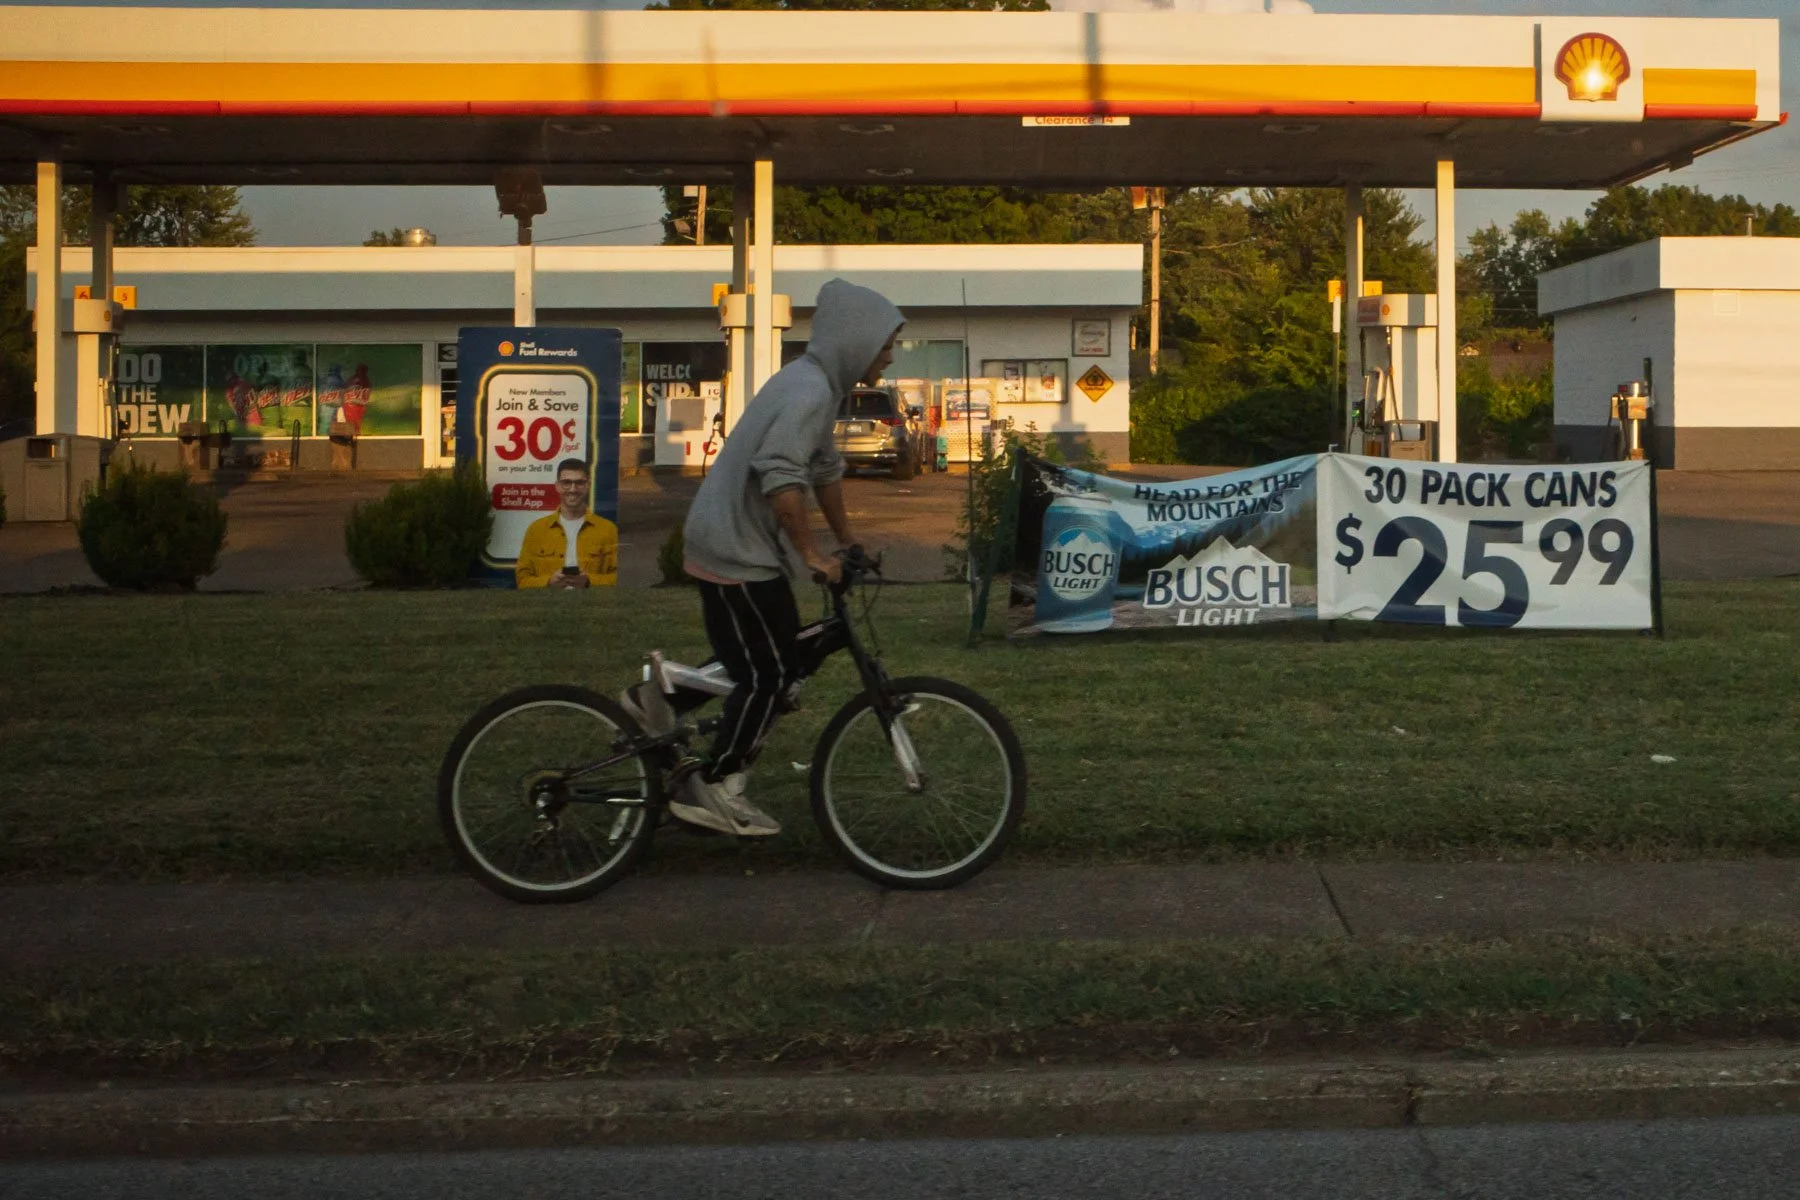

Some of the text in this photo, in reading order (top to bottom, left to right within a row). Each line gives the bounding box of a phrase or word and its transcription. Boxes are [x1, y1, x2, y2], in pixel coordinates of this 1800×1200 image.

[1035, 116, 1094, 125] Clearance
[520, 348, 577, 356] Fuel Rewards
[117, 353, 162, 383] DO
[118, 384, 156, 403] THE
[529, 388, 566, 396] Members
[496, 398, 579, 411] Join & Save
[118, 404, 191, 433] DEW
[529, 464, 542, 472] 3rd
[544, 464, 553, 472] fill
[501, 487, 545, 496] Join in the
[1134, 471, 1302, 501] HEAD FOR THE
[1364, 466, 1617, 508] 30 PACK CANS
[501, 498, 544, 508] Shell App
[1147, 495, 1285, 522] MOUNTAINS
[1044, 550, 1115, 577] BUSCH
[1053, 577, 1101, 590] LIGHT
[1145, 564, 1288, 606] BUSCH
[1177, 608, 1260, 626] LIGHT
